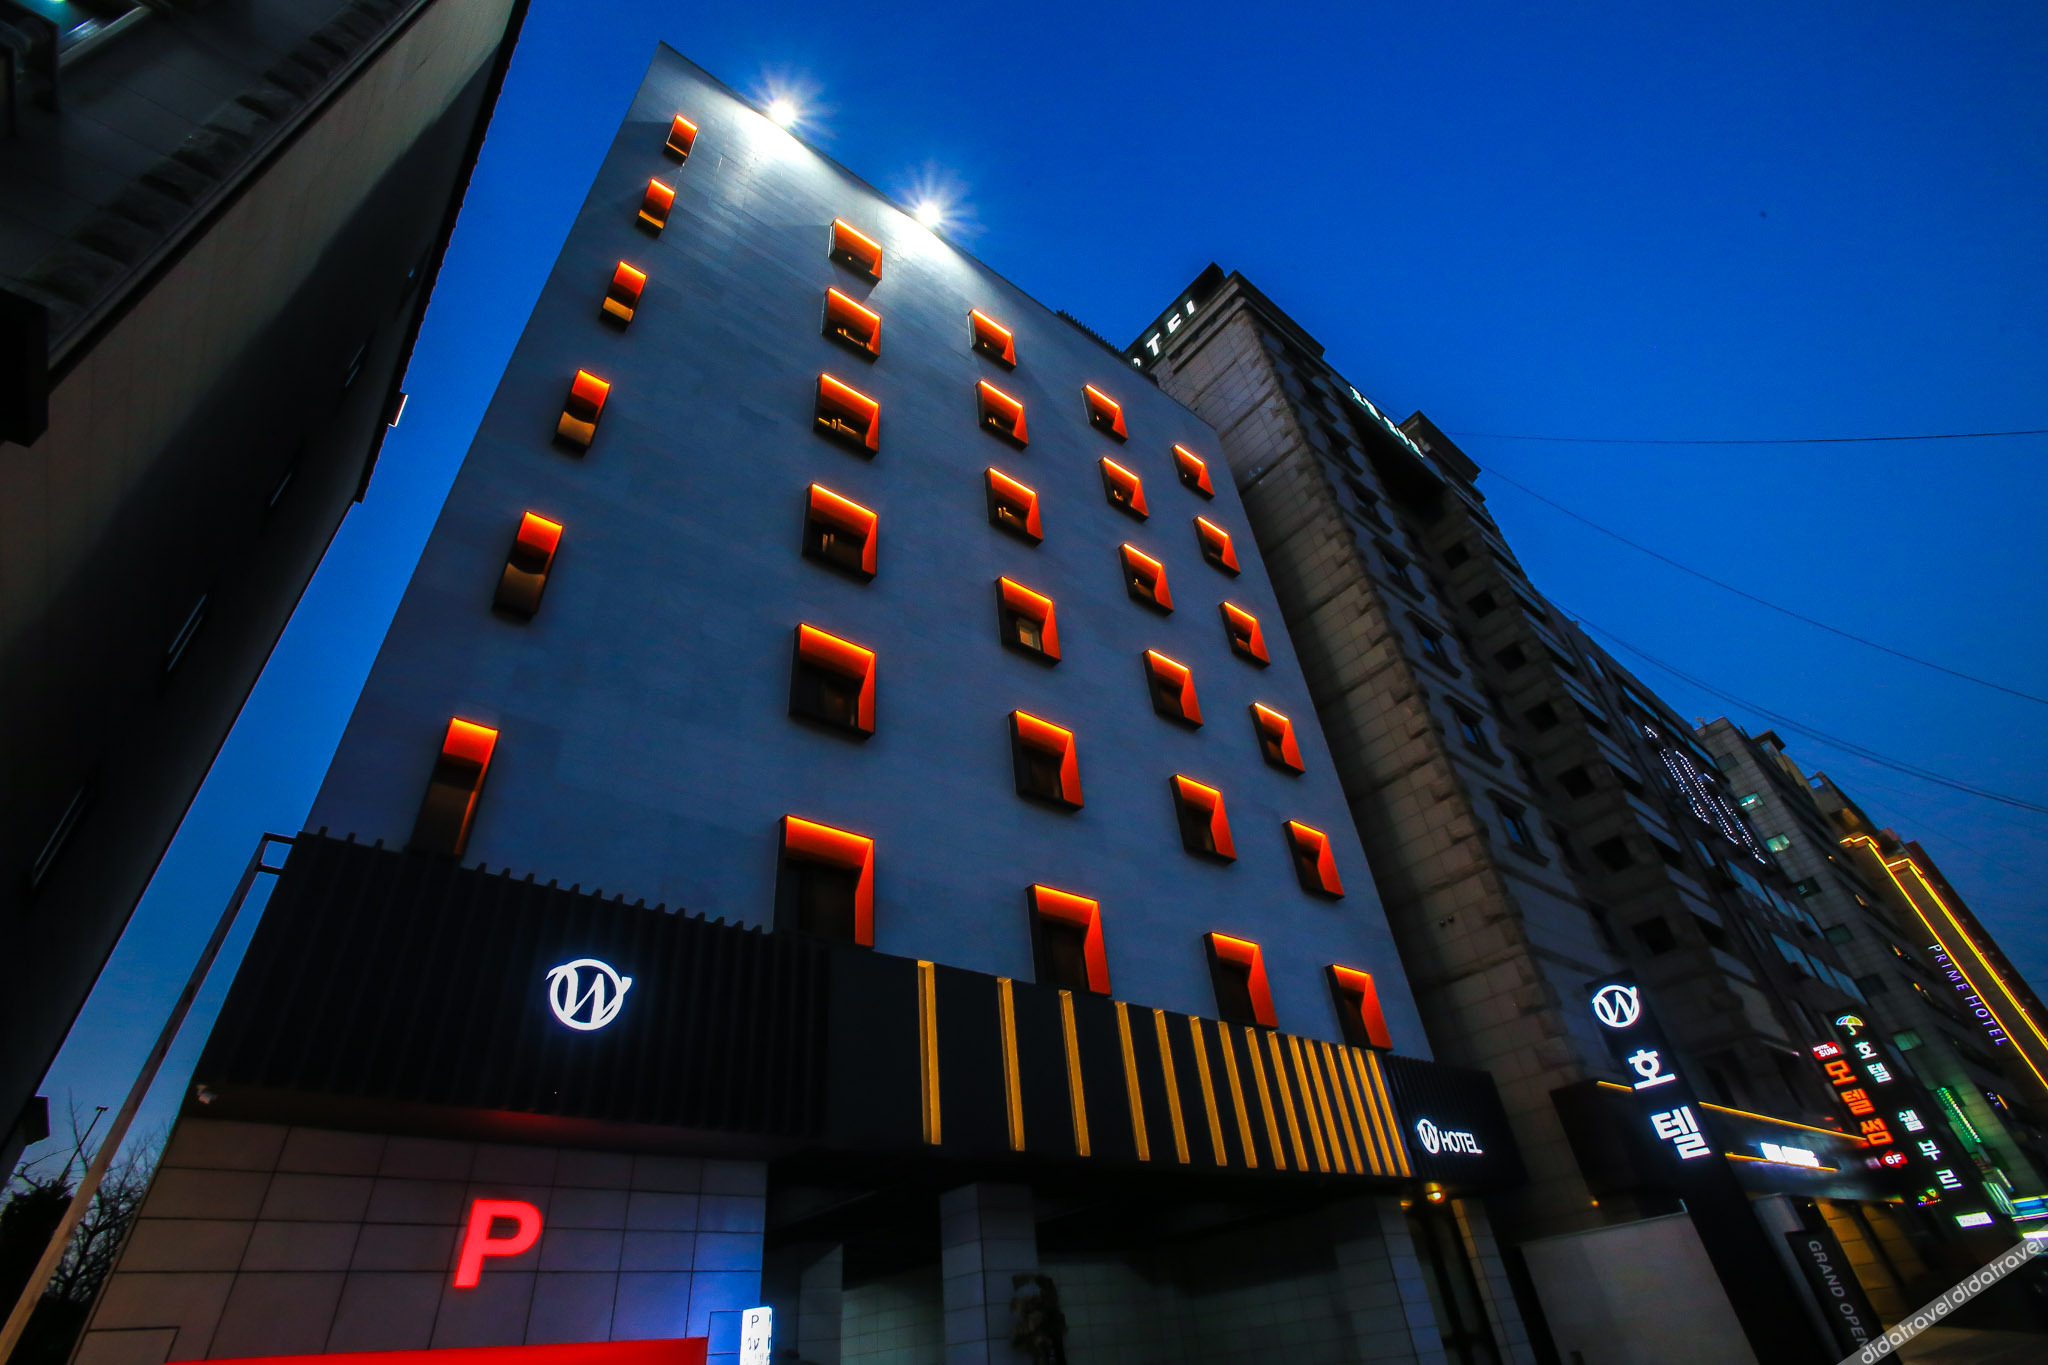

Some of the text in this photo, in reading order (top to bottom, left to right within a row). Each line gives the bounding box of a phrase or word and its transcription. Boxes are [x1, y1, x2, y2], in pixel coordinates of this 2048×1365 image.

[1927, 943, 2009, 1046] PRIME HOTEL
[1818, 1046, 1838, 1057] SUM
[1854, 1041, 1893, 1083] 호텔
[1628, 1049, 1712, 1160] 호텔
[1439, 1130, 1483, 1155] HOTEL
[1884, 1153, 1903, 1165] 6F
[452, 1198, 543, 1289] P
[1808, 1240, 1846, 1298] GRAND
